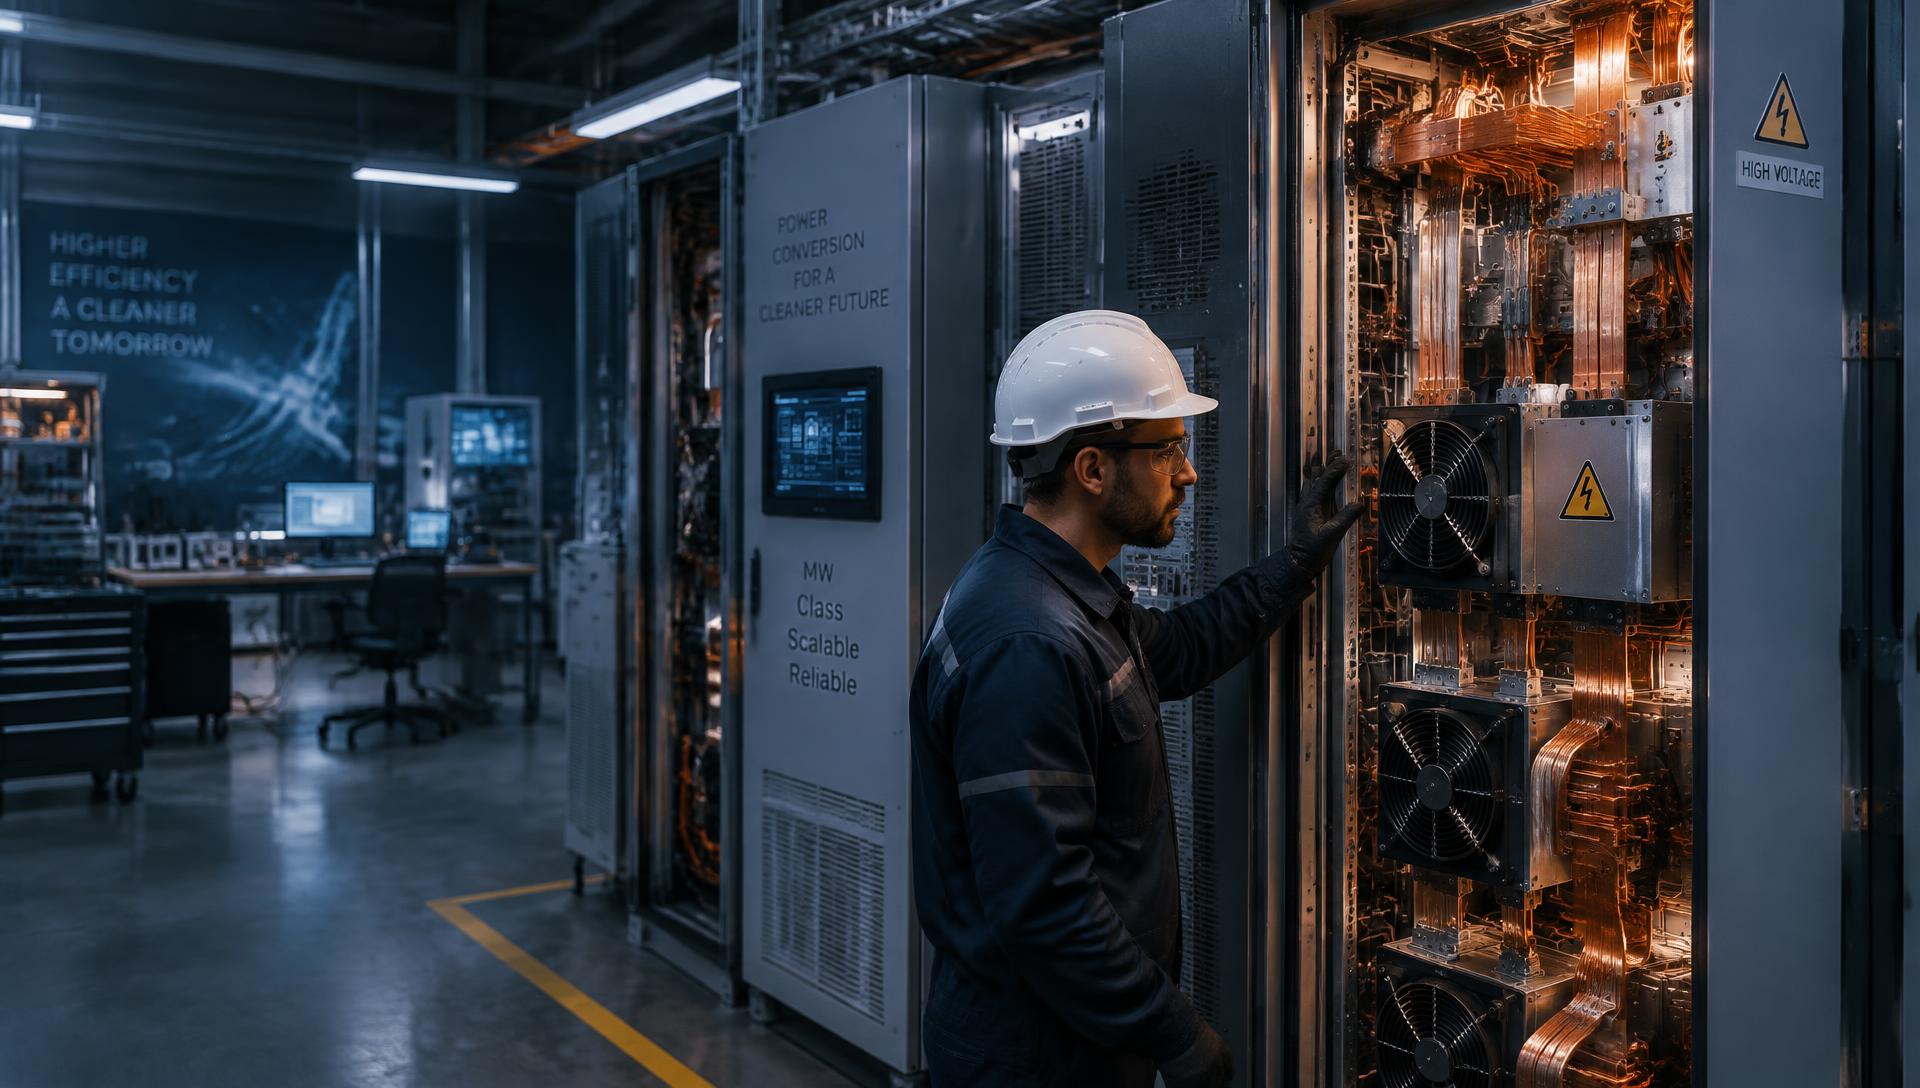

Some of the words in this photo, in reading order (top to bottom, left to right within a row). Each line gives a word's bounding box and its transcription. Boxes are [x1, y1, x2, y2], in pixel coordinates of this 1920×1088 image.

[1742, 160, 1770, 181] HIGH
[777, 208, 827, 235] POWER
[49, 231, 148, 259] HIGHER
[772, 231, 865, 265] CONVERSION
[49, 262, 199, 294] EFFICIENCY
[794, 268, 821, 289] FOR
[825, 266, 835, 285] A
[50, 296, 71, 320] A
[76, 298, 197, 326] CLEANER
[759, 297, 824, 323] CLEANER
[828, 288, 889, 313] FUTURE
[50, 328, 213, 358] TOMORROW
[803, 561, 834, 583] MW
[797, 593, 844, 622] Class
[788, 627, 860, 660] Scalable
[789, 662, 857, 696] Reliable
